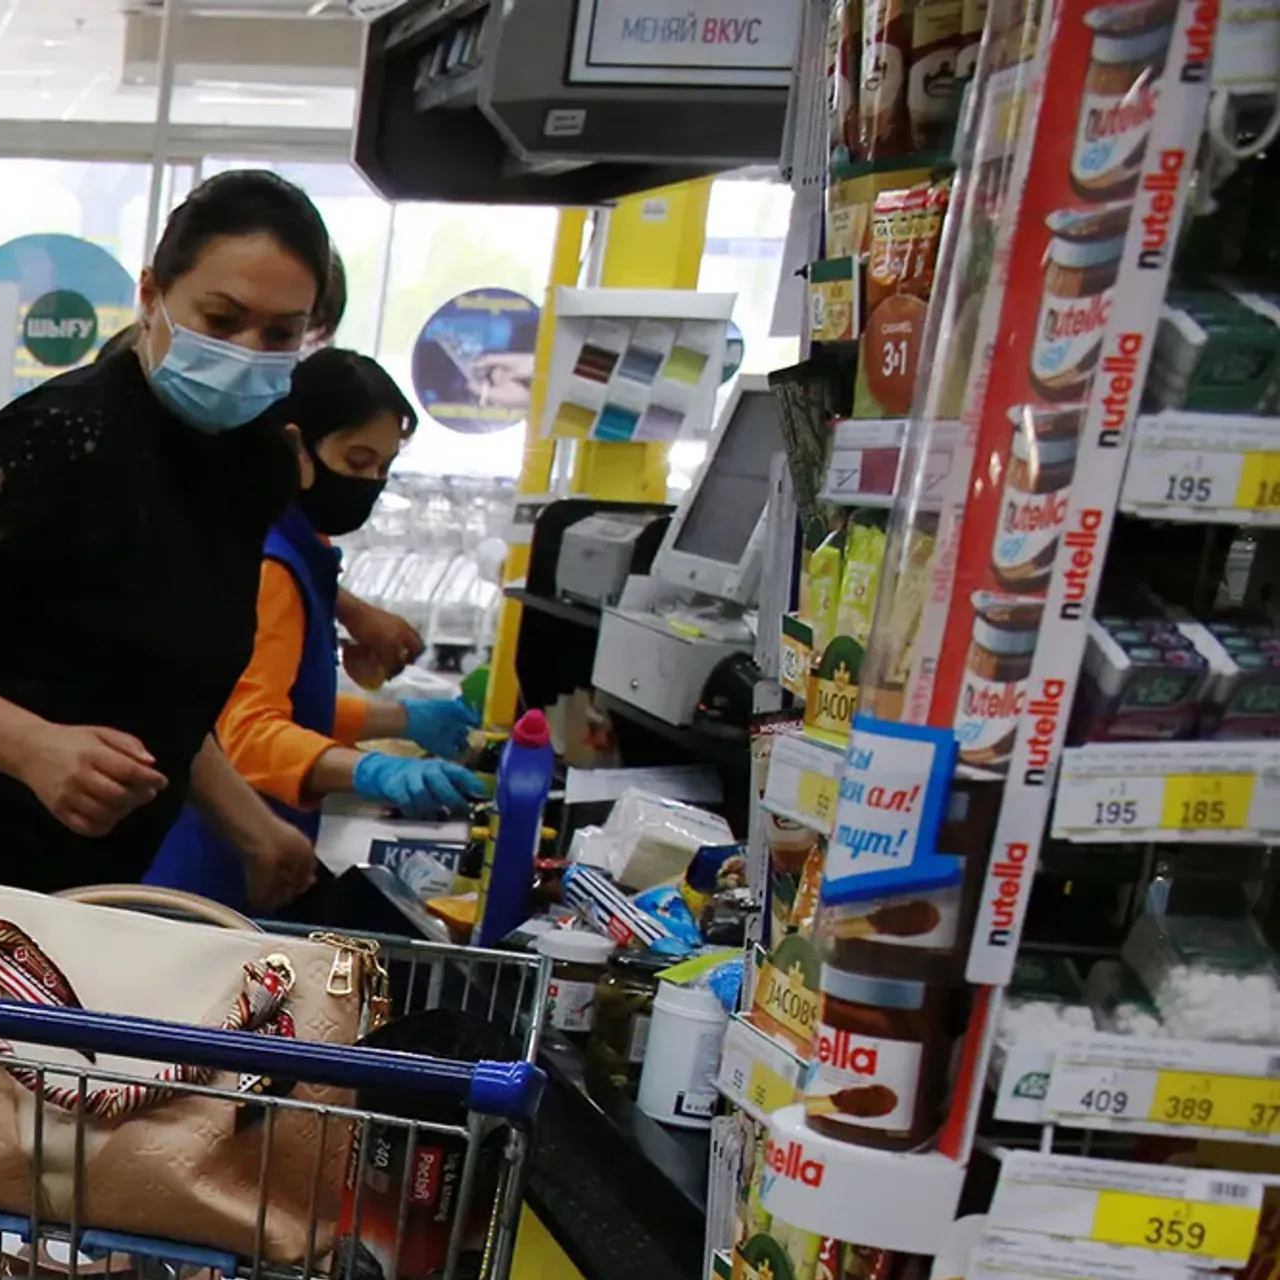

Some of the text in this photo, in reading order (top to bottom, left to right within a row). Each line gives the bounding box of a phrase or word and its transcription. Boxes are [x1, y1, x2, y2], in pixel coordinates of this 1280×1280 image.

[620, 12, 761, 45] МЕНЯЙ ВКУС
[1137, 149, 1185, 270] nutella
[1097, 332, 1144, 448] nutella
[1164, 475, 1212, 502] 195
[1060, 509, 1103, 620] nutella
[1023, 679, 1066, 786] nutella
[1094, 801, 1226, 825] 195 185
[988, 841, 1029, 946] nutella
[818, 1028, 878, 1076] ella
[1080, 1090, 1280, 1129] 409 389 37
[762, 1139, 825, 1188] tella
[1144, 1217, 1206, 1250] 359
